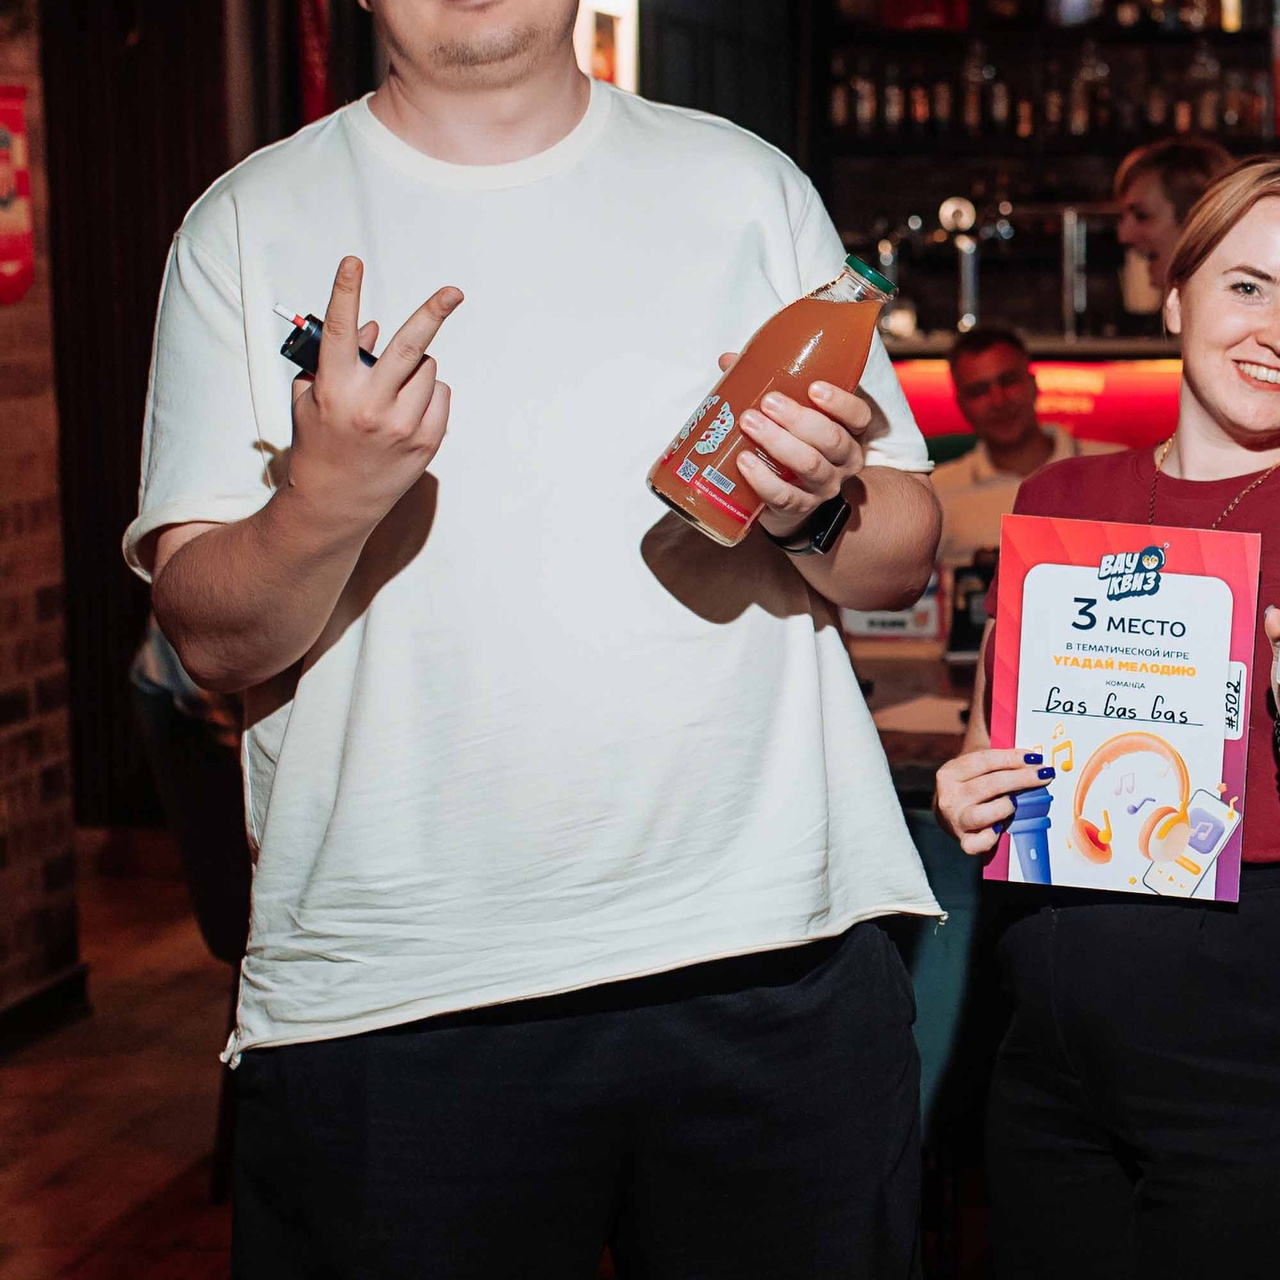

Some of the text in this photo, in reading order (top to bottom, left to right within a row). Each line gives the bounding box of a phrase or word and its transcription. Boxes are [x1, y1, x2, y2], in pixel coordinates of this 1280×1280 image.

[1100, 552, 1140, 578] ВАУ
[1108, 571, 1157, 596] КВИЗ
[1071, 597, 1187, 638] 3 МЕСТО
[1066, 642, 1190, 660] В ТЕМАТИЧЕСКОЙ ИГРЕ
[1053, 655, 1197, 677] УГАДАЙ МЕЛОДИЮ
[1105, 679, 1146, 690] КОМАНДА
[1045, 686, 1189, 724] Gas Gas Gas
